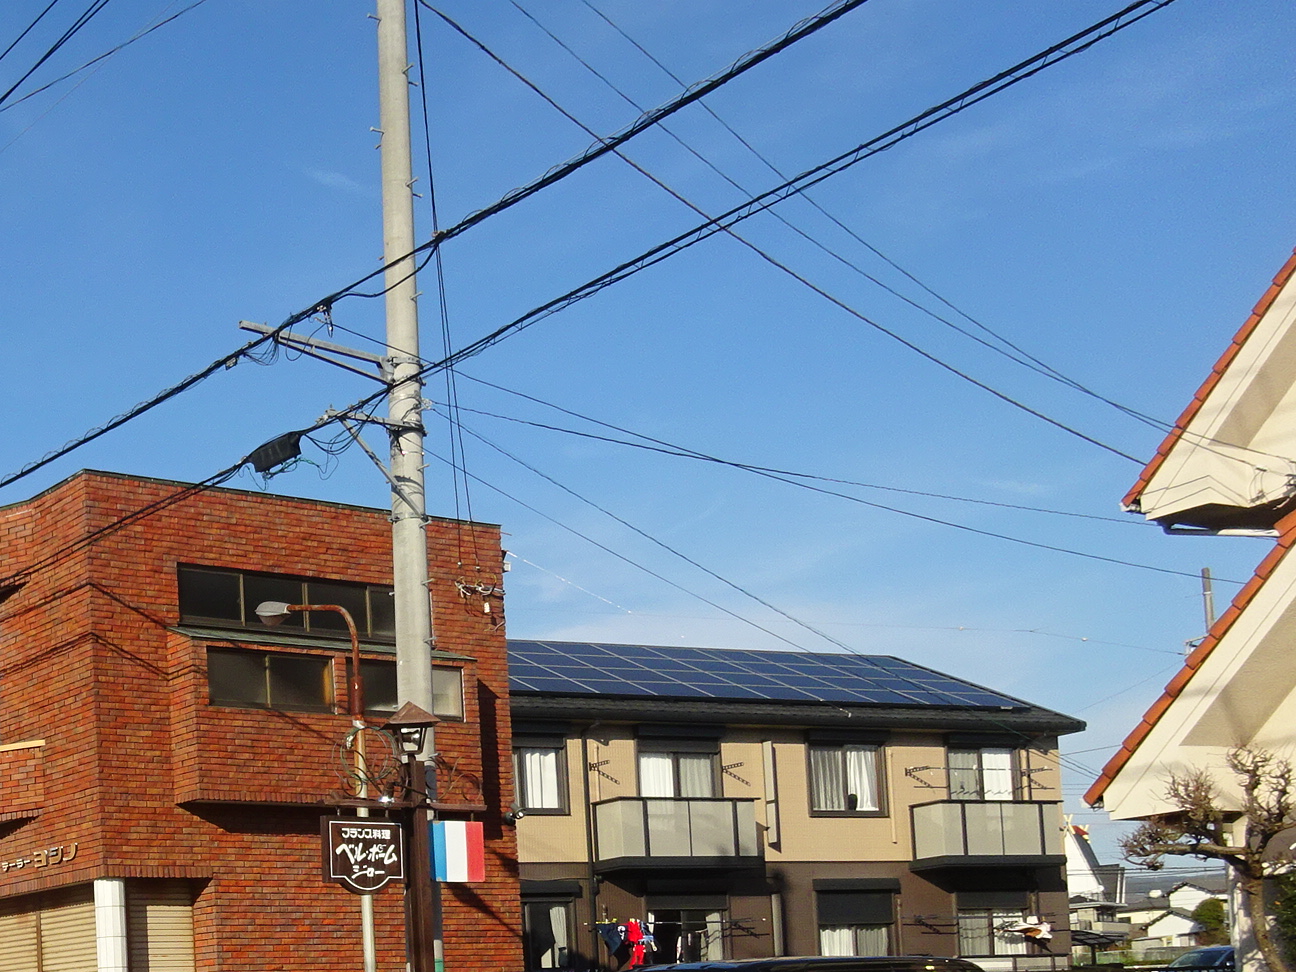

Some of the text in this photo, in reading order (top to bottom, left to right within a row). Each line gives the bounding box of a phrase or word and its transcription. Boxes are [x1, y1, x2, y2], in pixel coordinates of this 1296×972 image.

[341, 827, 391, 840] フランス料理
[351, 865, 385, 880] ジロー
